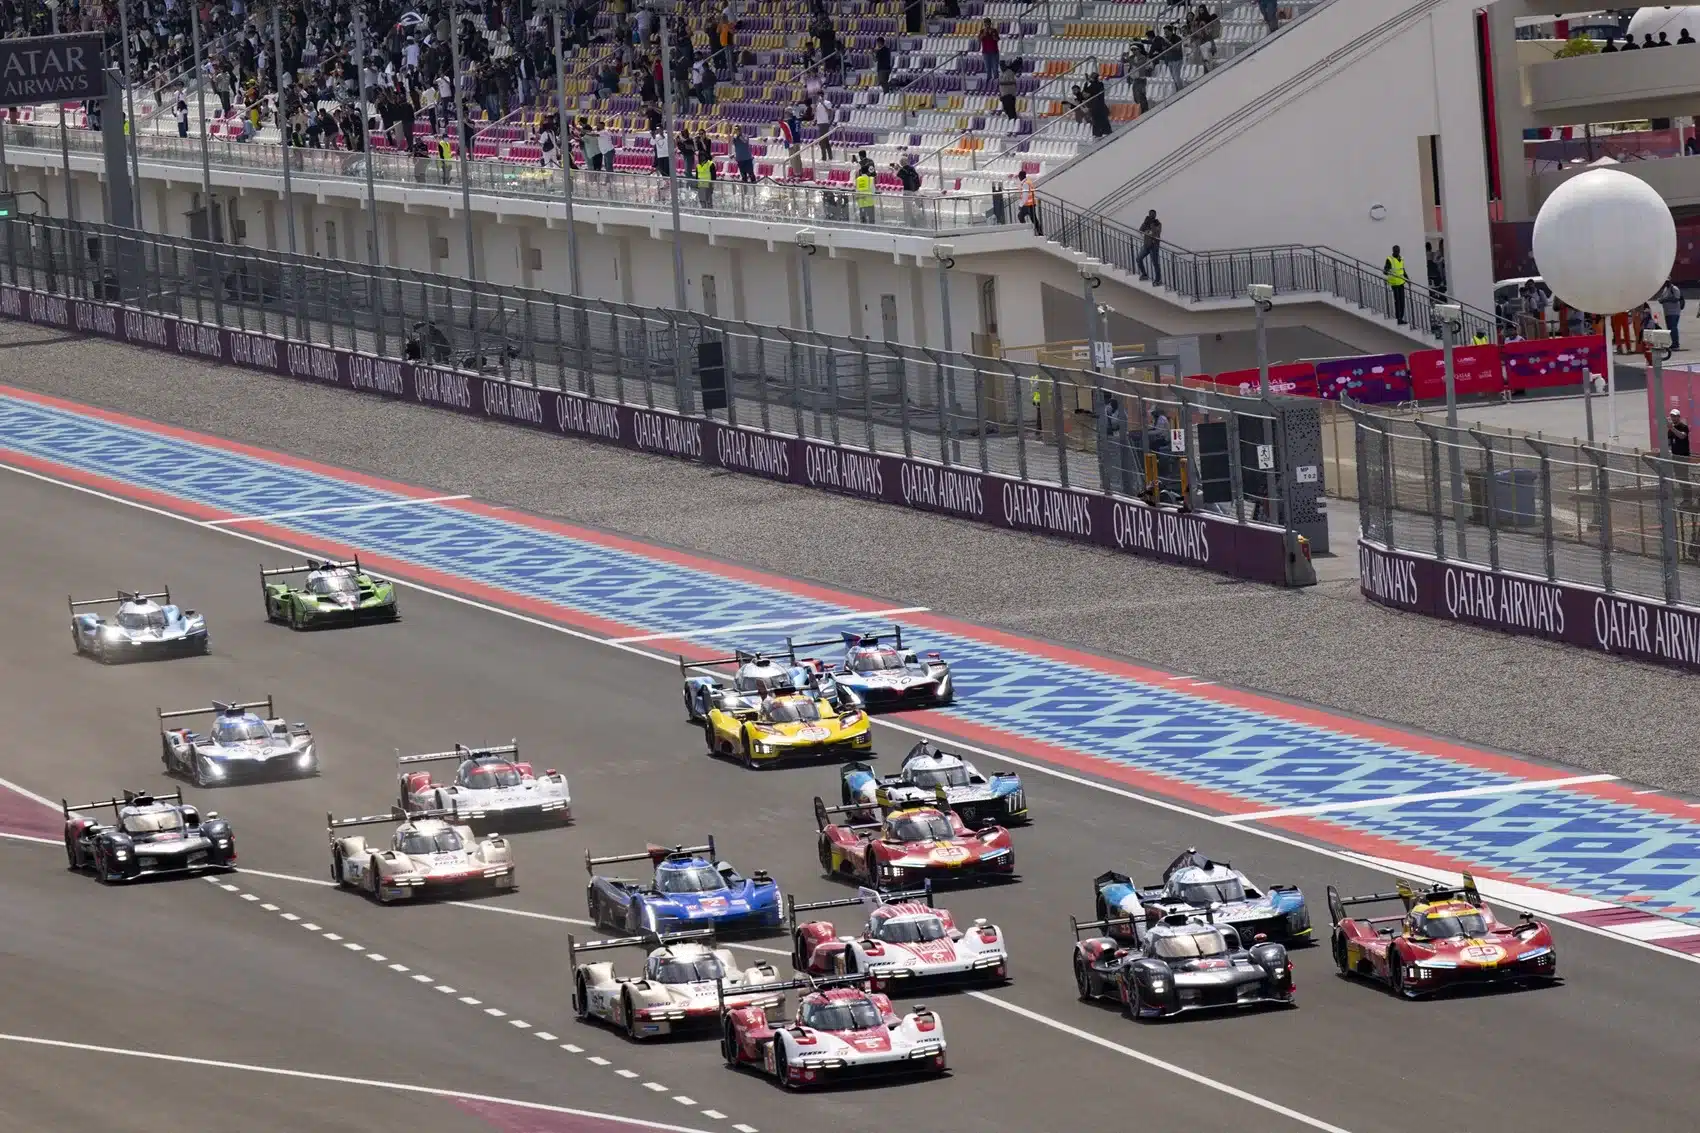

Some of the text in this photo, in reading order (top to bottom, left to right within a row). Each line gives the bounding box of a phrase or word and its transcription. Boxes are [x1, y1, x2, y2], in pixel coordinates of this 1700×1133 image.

[4, 75, 89, 97] AIRWAYS
[287, 343, 310, 376] QATAR
[350, 355, 403, 394] QATAR AIRWAYS
[414, 366, 470, 408] QATAR AIRWAYS
[482, 380, 543, 424] QATAR AIRWAYS
[556, 394, 620, 440] QATAR AIRWAYS
[634, 411, 702, 457] QATAR AIRWAYS
[717, 427, 789, 477] QATAR AIRWAYS
[806, 444, 883, 495] QATAR AIRWAYS
[901, 462, 984, 516] QATAR AIRWAYS
[1002, 482, 1092, 536] QATAR AIRWAYS
[1113, 502, 1209, 562] QATAR AIRWAYS
[1371, 551, 1418, 605] AIRWAYS
[1445, 567, 1565, 634] QATAR AIRWAYS
[1594, 596, 1652, 653] QATAR
